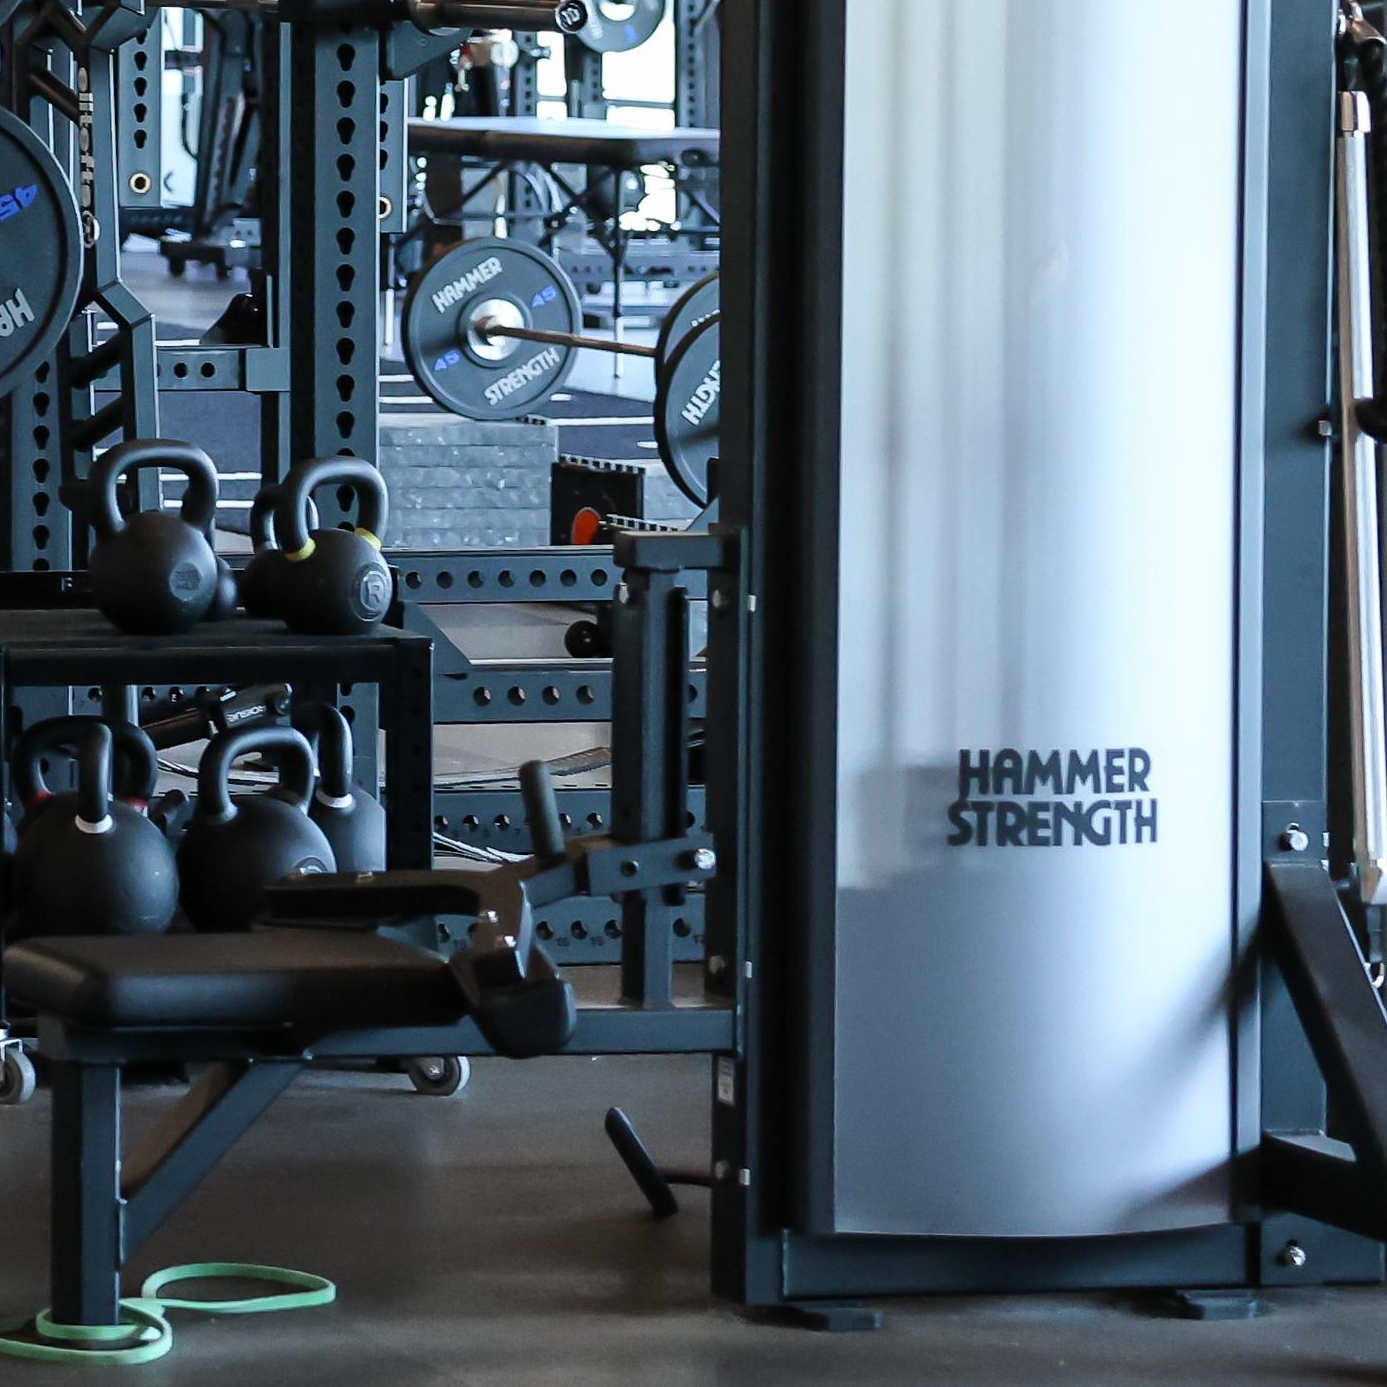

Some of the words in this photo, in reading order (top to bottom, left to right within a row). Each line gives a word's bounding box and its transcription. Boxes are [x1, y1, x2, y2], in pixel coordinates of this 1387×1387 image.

[432, 256, 505, 314] HAMMER
[530, 285, 558, 309] 45
[482, 347, 561, 406] STRENGTH
[958, 747, 1152, 796] HAMMER
[946, 797, 1158, 847] STRENGTH
